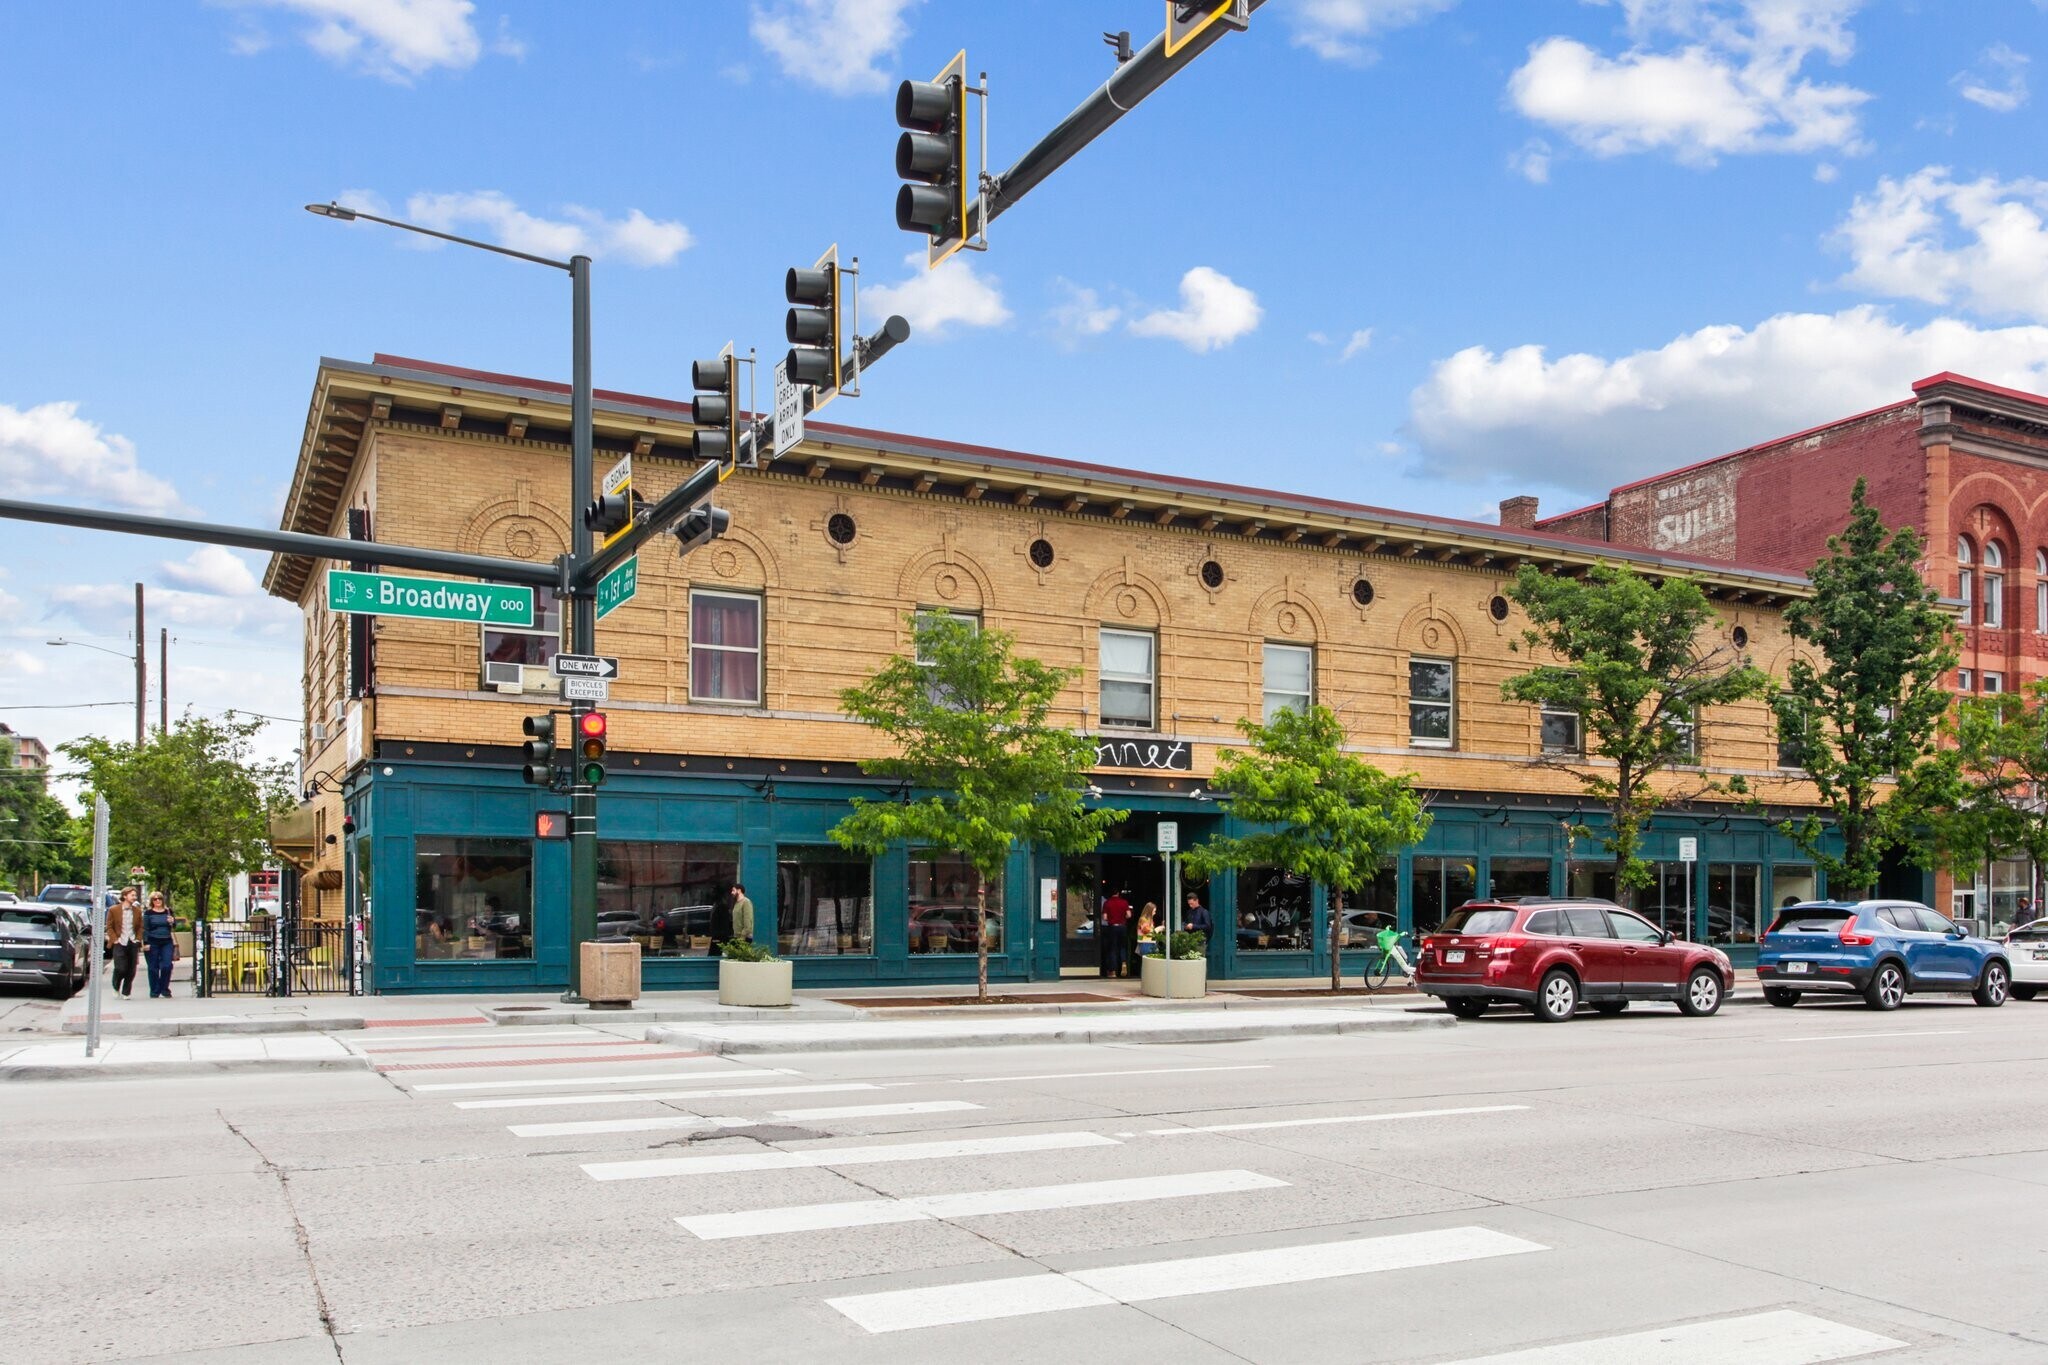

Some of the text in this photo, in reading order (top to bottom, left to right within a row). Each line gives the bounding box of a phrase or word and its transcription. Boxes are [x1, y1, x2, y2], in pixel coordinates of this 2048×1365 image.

[779, 401, 798, 426] ARROW
[782, 422, 796, 444] ONLY
[610, 461, 629, 488] SIGNAL
[366, 588, 374, 599] S
[380, 581, 492, 620] Broadway
[561, 660, 599, 671] ONE WAY
[570, 680, 603, 689] BICYCLES
[570, 688, 604, 697] EXCEPTED
[1092, 741, 1187, 771] ornet
